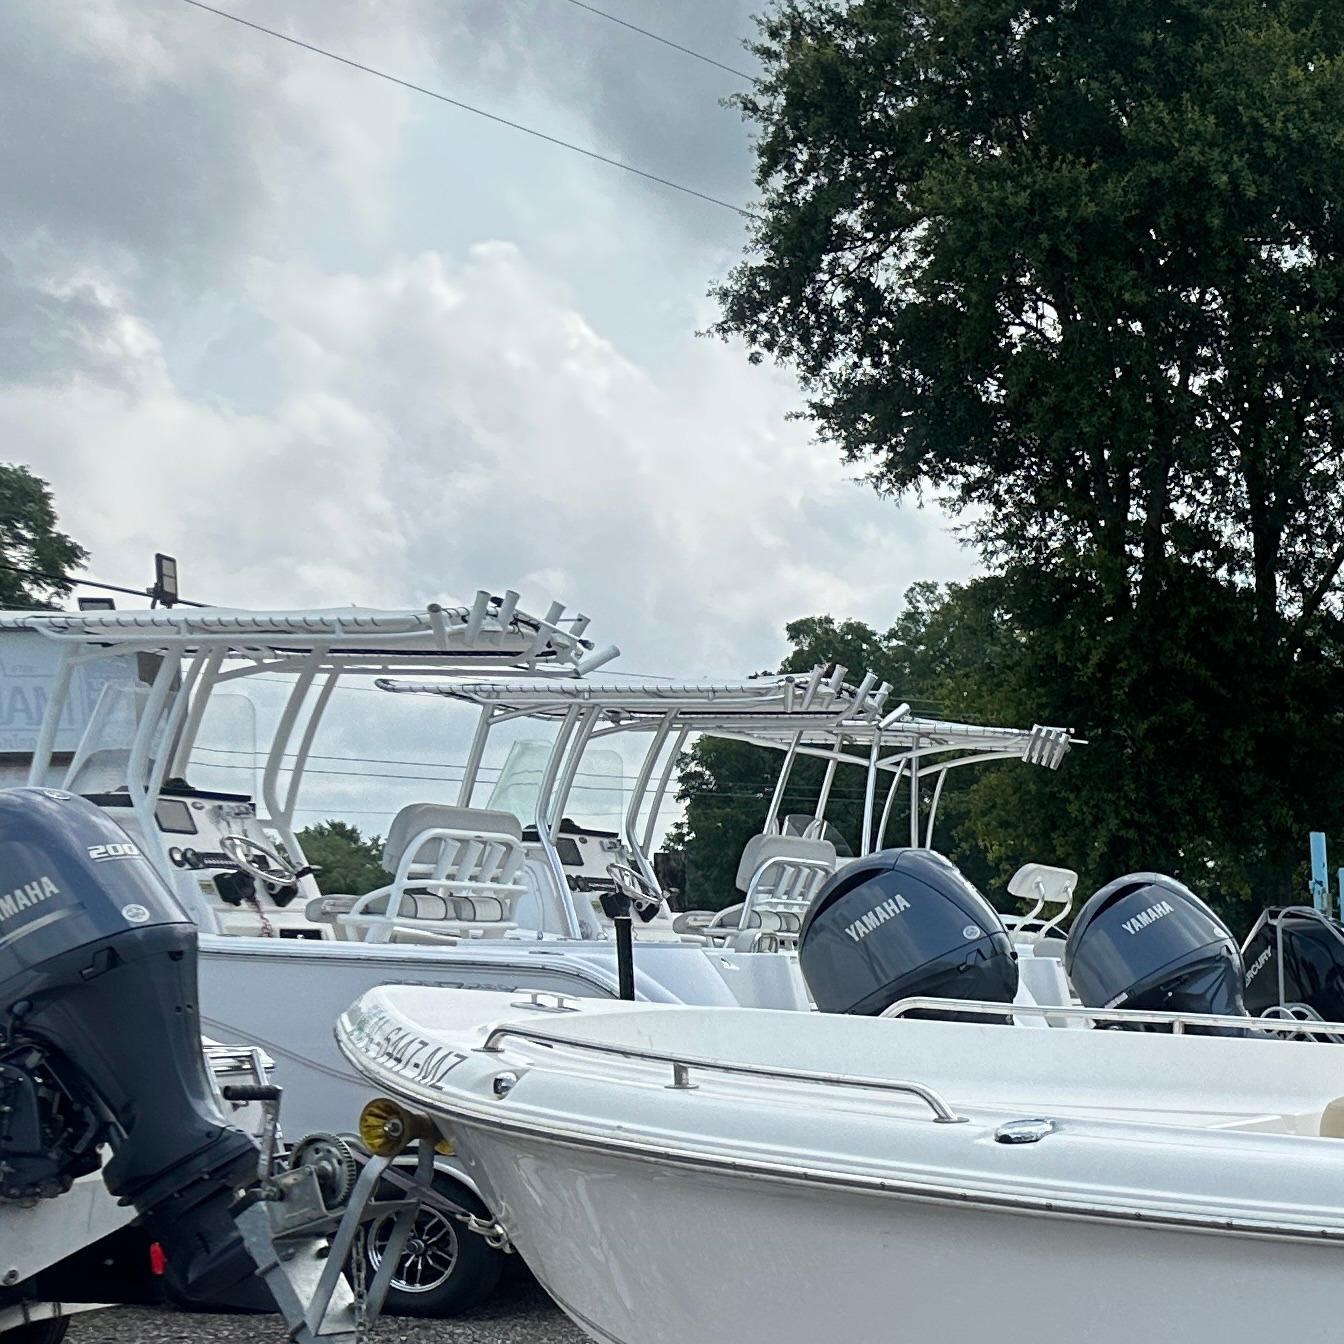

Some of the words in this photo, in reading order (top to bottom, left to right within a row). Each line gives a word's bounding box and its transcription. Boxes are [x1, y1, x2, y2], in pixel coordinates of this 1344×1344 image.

[88, 843, 140, 860] 200
[0, 876, 60, 922] MAHA
[845, 894, 911, 942] YAMAHA
[1121, 901, 1174, 935] YAMAHA
